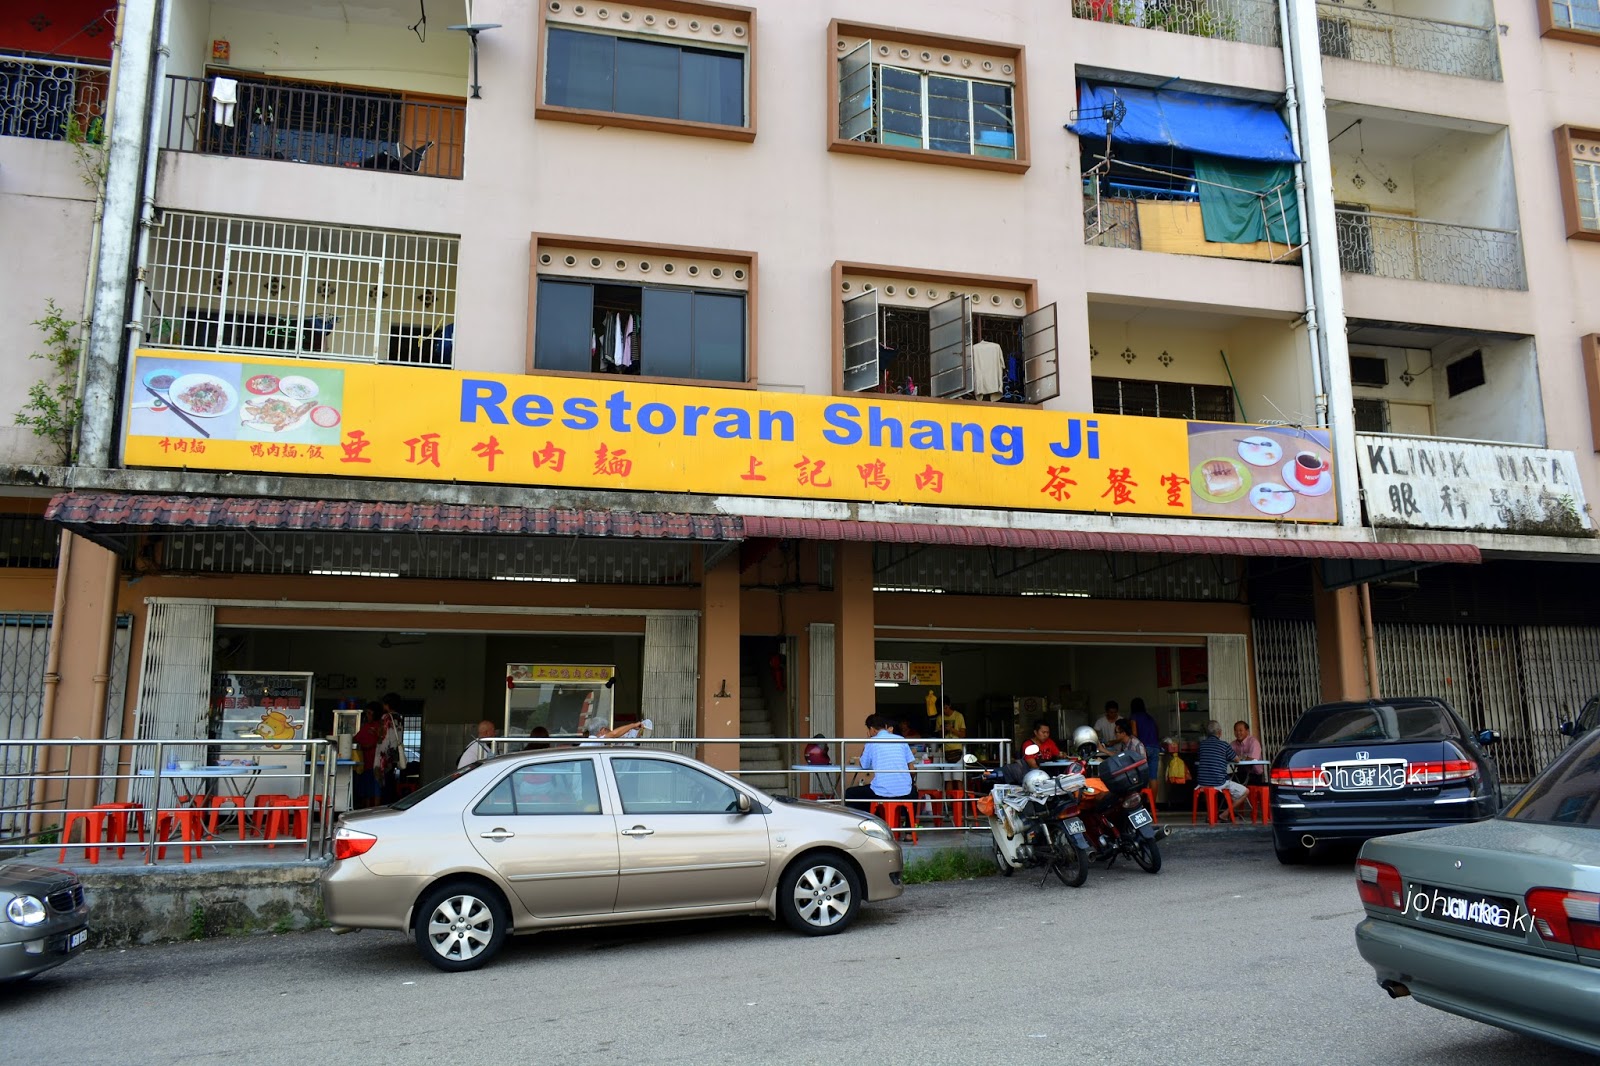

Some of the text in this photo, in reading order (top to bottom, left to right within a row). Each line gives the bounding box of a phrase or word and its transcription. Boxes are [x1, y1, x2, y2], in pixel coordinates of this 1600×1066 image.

[459, 379, 1101, 466] Restoran Shang Ji
[740, 454, 945, 494] 上記鴨肉
[1367, 444, 1569, 486] KLINIK MATA
[1040, 465, 1190, 508] 茶餐室
[881, 663, 904, 671] LAKSA
